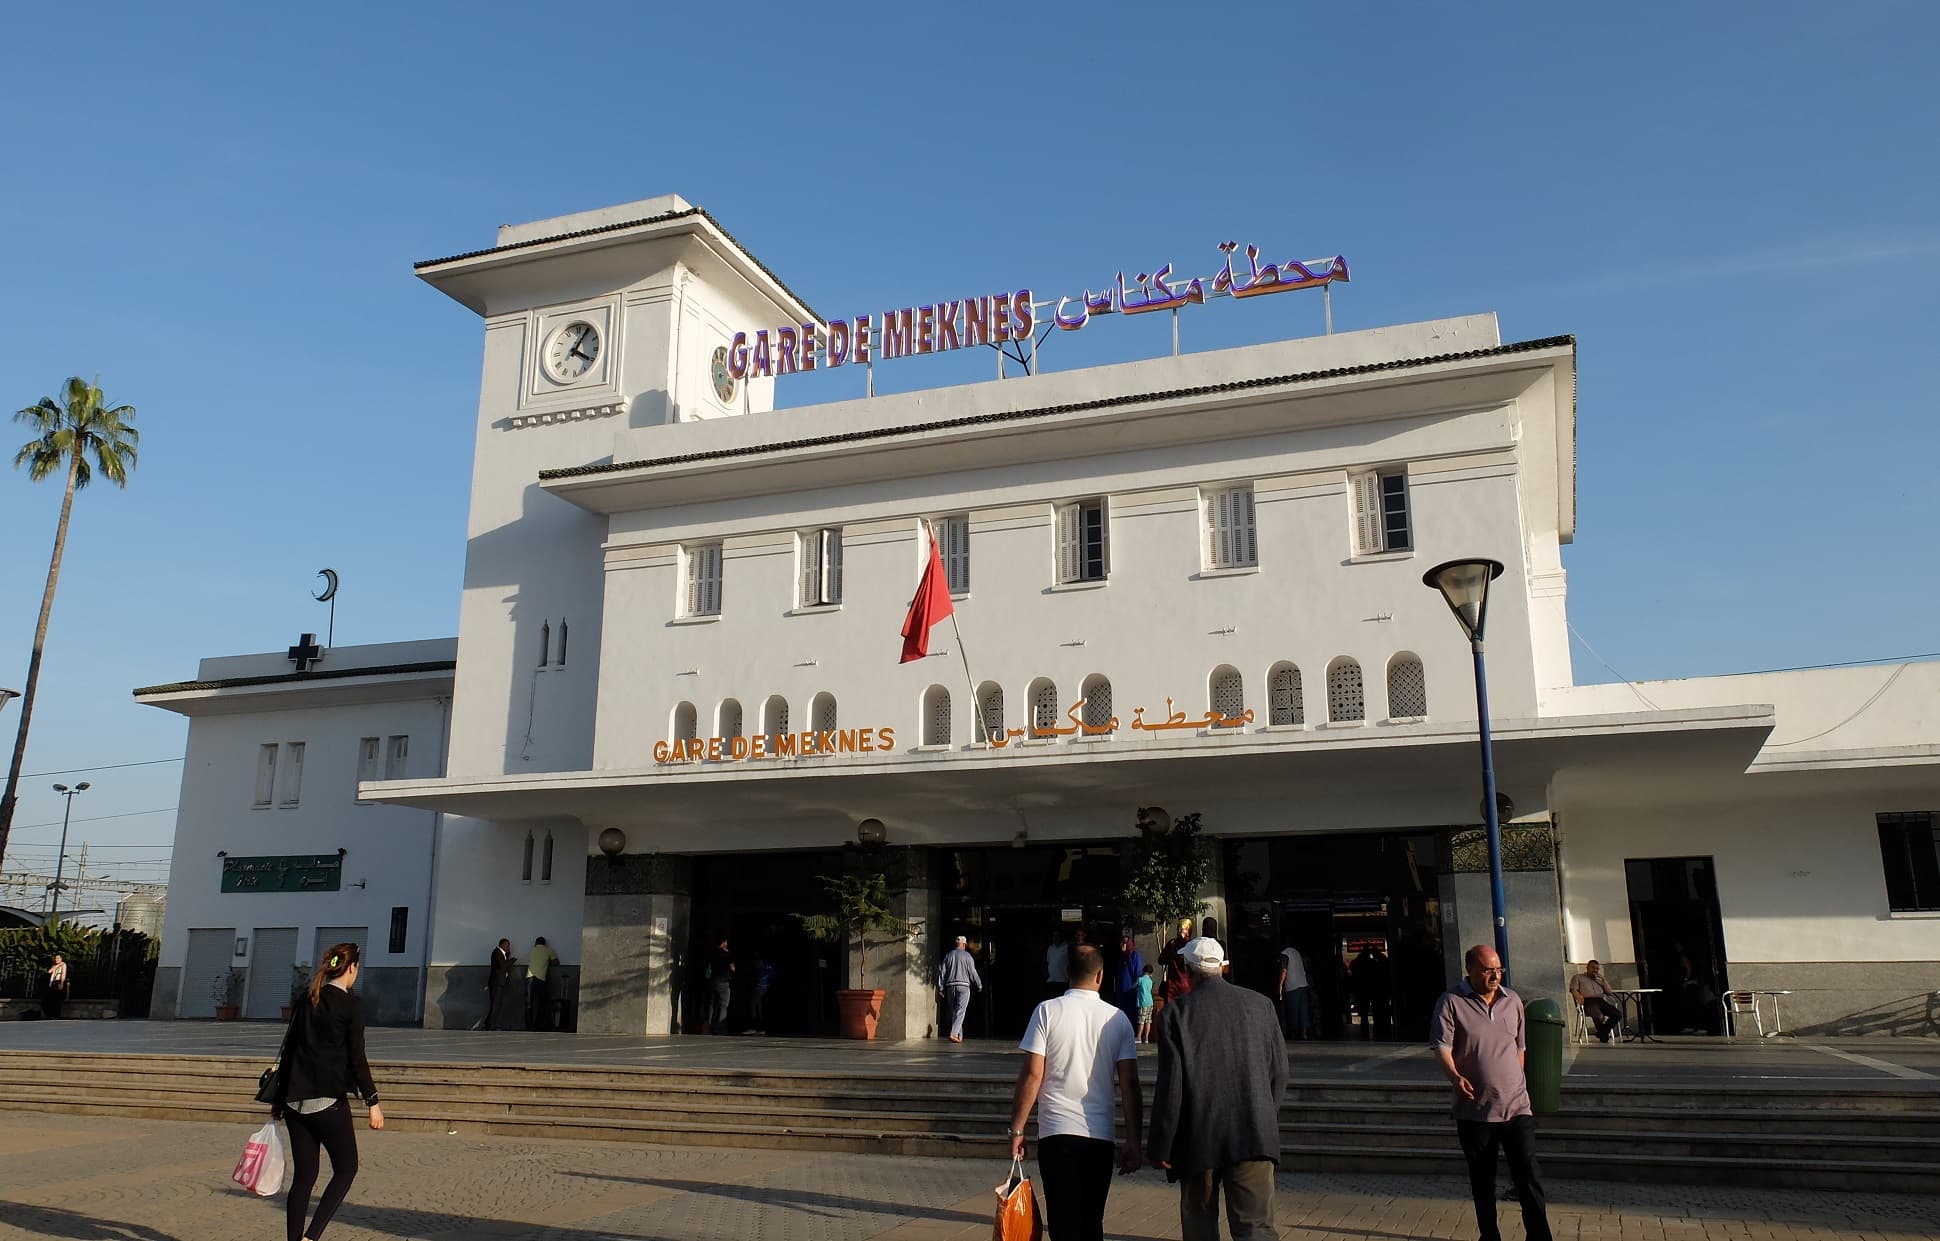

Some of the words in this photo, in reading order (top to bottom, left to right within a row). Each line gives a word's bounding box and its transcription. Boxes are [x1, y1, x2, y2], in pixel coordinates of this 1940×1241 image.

[1212, 240, 1350, 298] محطة
[1054, 262, 1205, 331] مكناس
[727, 323, 817, 380] GARE
[826, 314, 872, 368] DE
[881, 289, 1034, 359] MEKNES
[991, 698, 1120, 748] مكناس
[1131, 696, 1255, 731] محطة
[653, 737, 725, 763] GARE
[731, 734, 769, 760] DE
[774, 728, 896, 758] MEKNES
